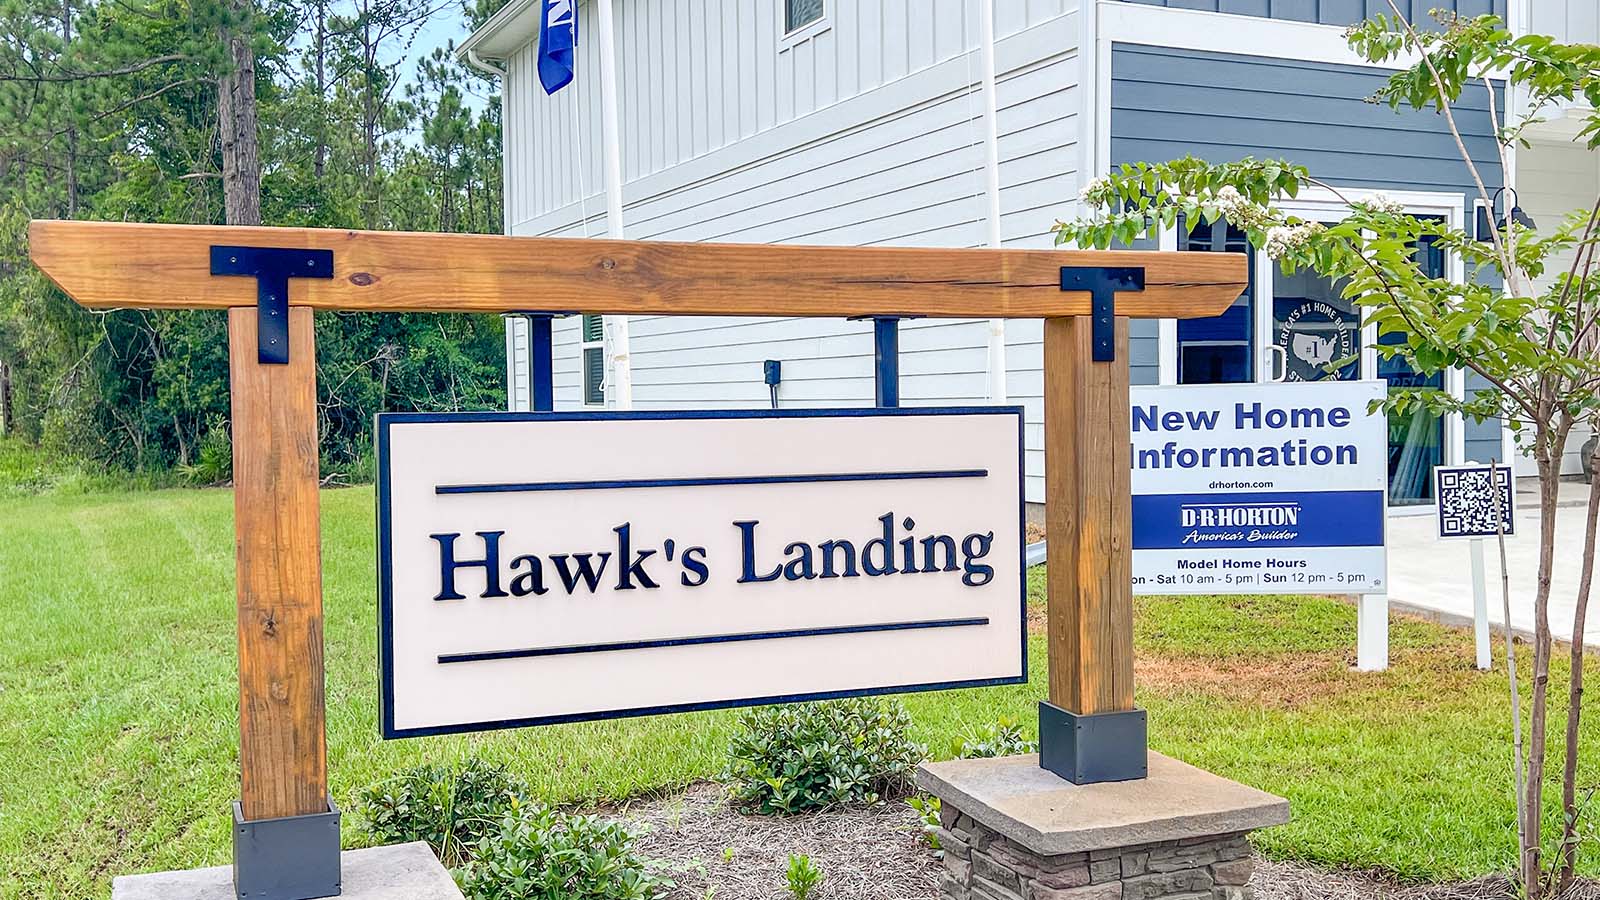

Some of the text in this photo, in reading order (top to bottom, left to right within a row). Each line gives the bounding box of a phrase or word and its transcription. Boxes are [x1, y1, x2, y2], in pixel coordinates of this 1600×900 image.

[1280, 302, 1350, 360] ERICA'S #1 HOME BUILDER
[1306, 341, 1320, 358] #1
[1132, 402, 1351, 432] New Home
[1209, 480, 1273, 489] drhorton.com
[1182, 529, 1298, 544] America's Builder
[429, 511, 995, 602] Hawk's Landing
[1177, 558, 1307, 570] Model Home Hours
[1131, 576, 1146, 584] on
[1157, 574, 1177, 584] Sat
[1180, 574, 1194, 584] 10
[1196, 575, 1214, 584] am
[1225, 574, 1233, 584] 5
[1235, 575, 1253, 587] pm
[1263, 573, 1287, 583] Sun
[1291, 573, 1304, 583] 12
[1308, 574, 1326, 586] pm
[1337, 572, 1344, 582] 5
[1347, 573, 1366, 585] pm
